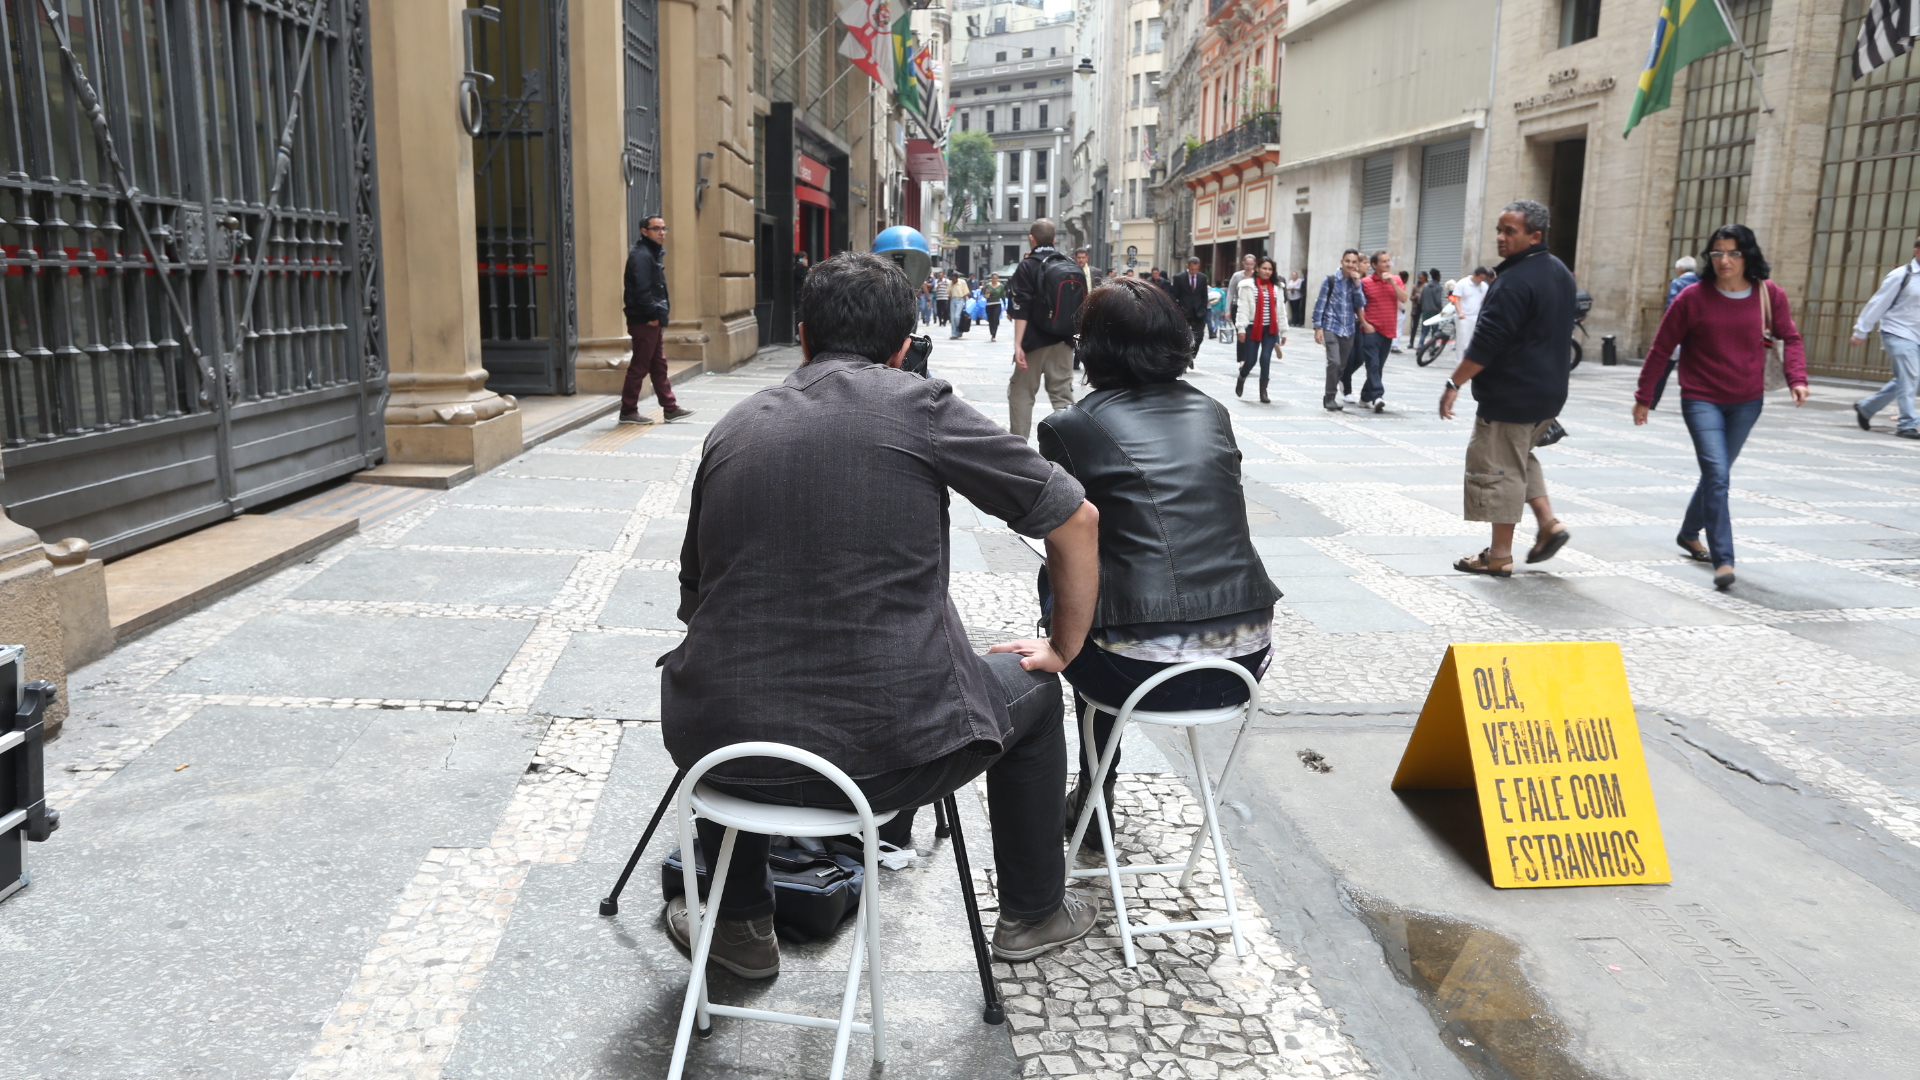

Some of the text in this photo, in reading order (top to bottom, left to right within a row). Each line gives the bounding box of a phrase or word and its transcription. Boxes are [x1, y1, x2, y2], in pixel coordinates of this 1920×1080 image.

[1473, 657, 1525, 713] OLÁ,
[1482, 717, 1618, 766] VENHA AQUI
[1495, 773, 1627, 823] E FALE COM
[1506, 829, 1646, 882] ESTRANHOS
[1625, 896, 1789, 1020] METROPOLITANA
